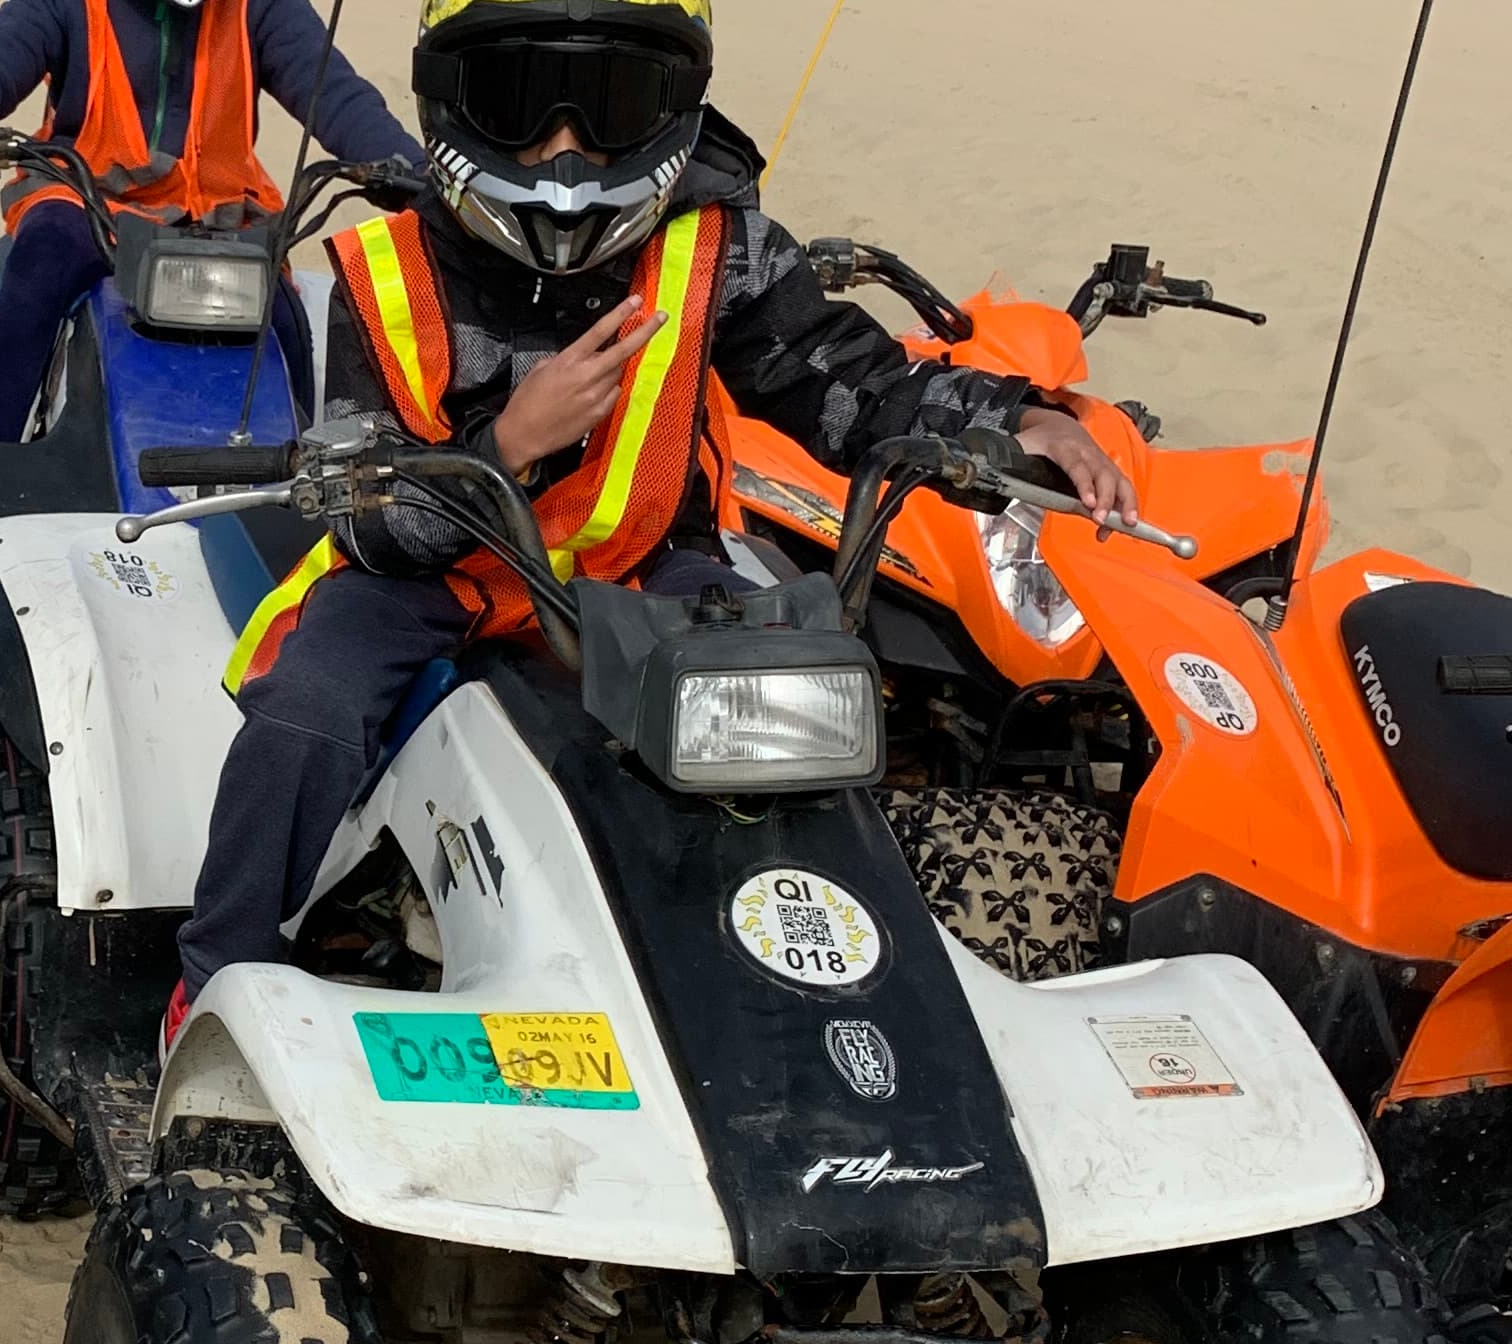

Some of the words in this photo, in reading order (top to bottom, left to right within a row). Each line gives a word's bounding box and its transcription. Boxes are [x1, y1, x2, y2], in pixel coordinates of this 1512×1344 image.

[104, 550, 143, 566] 018
[1179, 662, 1218, 679] 008
[1354, 644, 1401, 747] KYMCO
[1216, 711, 1244, 730] QP
[774, 878, 813, 902] QI
[784, 947, 847, 974] 018
[503, 1016, 600, 1026] NEVADA
[838, 1028, 869, 1047] FLY
[846, 1045, 879, 1064] RAC
[802, 1148, 893, 1192] FLY
